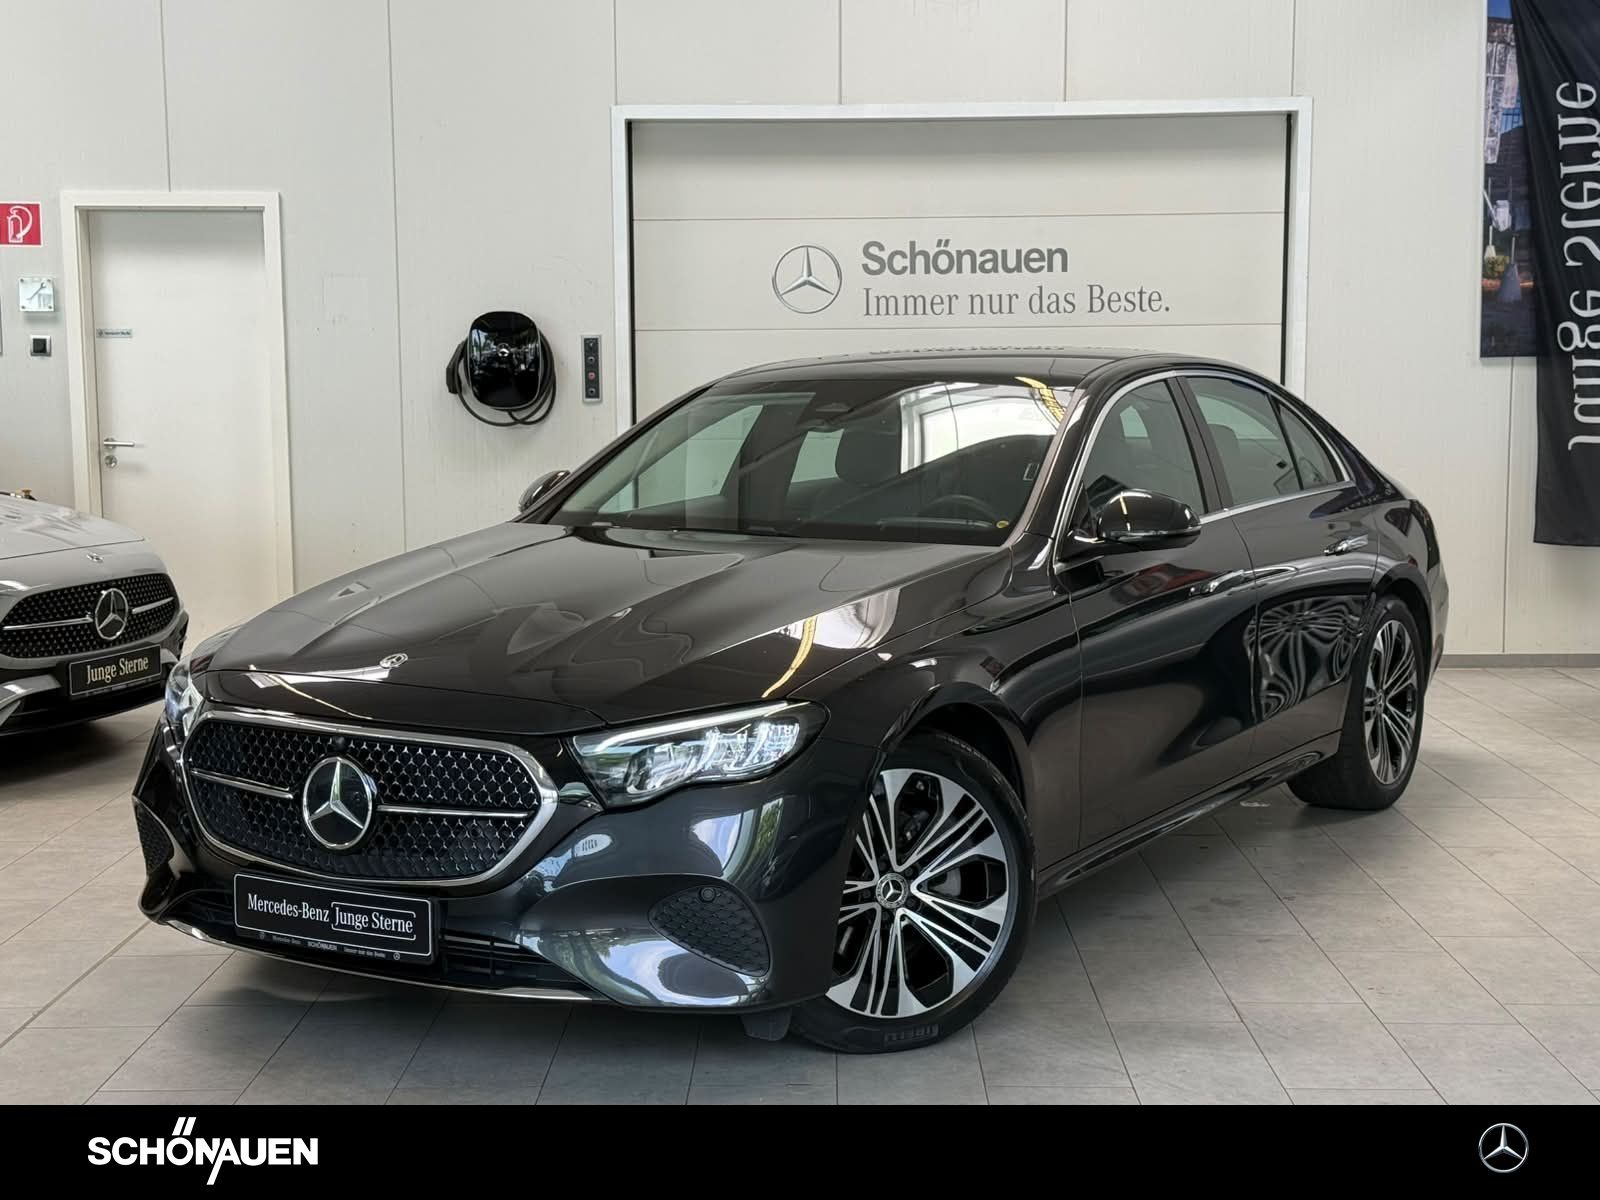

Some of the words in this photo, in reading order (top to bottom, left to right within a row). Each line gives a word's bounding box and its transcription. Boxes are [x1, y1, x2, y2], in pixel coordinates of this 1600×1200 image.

[861, 239, 1068, 275] Schönauen
[863, 287, 959, 316] Immer
[968, 295, 1019, 315] nur
[1028, 286, 1076, 314] das
[1087, 284, 1170, 313] Beste.
[87, 664, 117, 684] Junge
[119, 657, 149, 675] Sterne
[247, 893, 330, 922] Mercedes-Benz
[335, 906, 369, 930] Junge
[371, 911, 414, 933] Sterne
